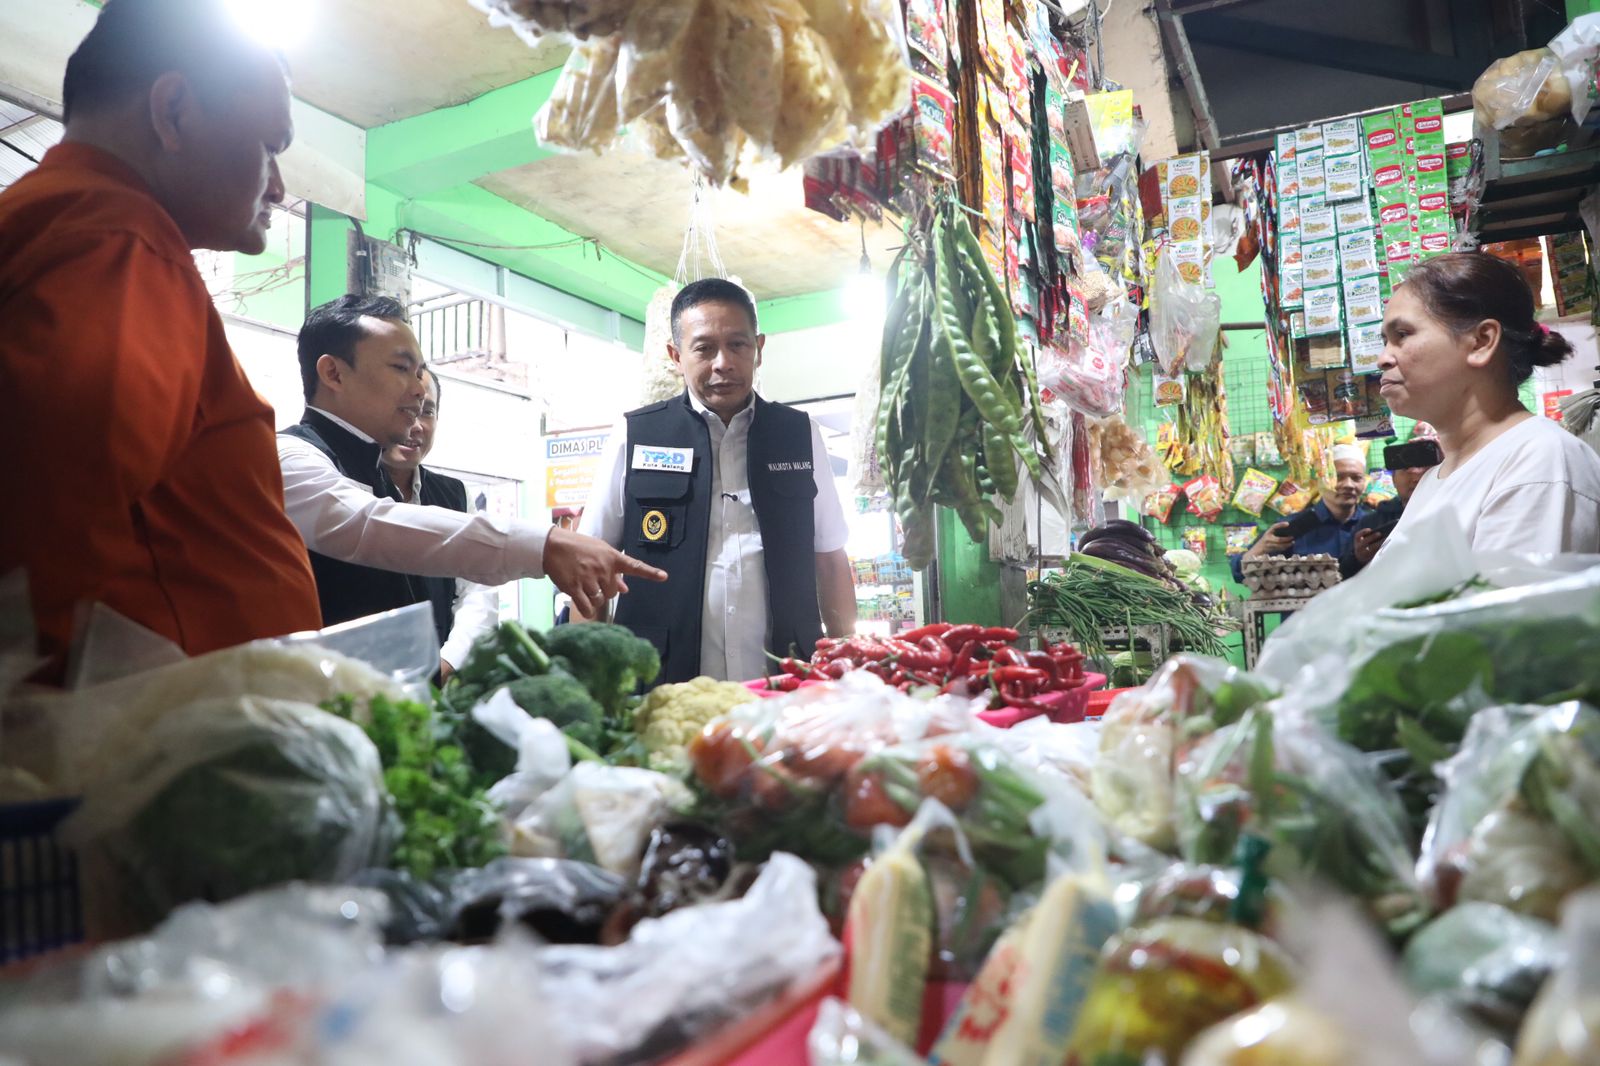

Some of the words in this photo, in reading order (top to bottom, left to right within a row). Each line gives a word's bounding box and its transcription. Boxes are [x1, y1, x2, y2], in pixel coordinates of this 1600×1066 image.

[551, 441, 585, 455] DIMAS
[588, 439, 606, 451] PL
[661, 463, 685, 471] Malang
[768, 462, 792, 471] WALIKOTA
[792, 461, 812, 470] MALANG
